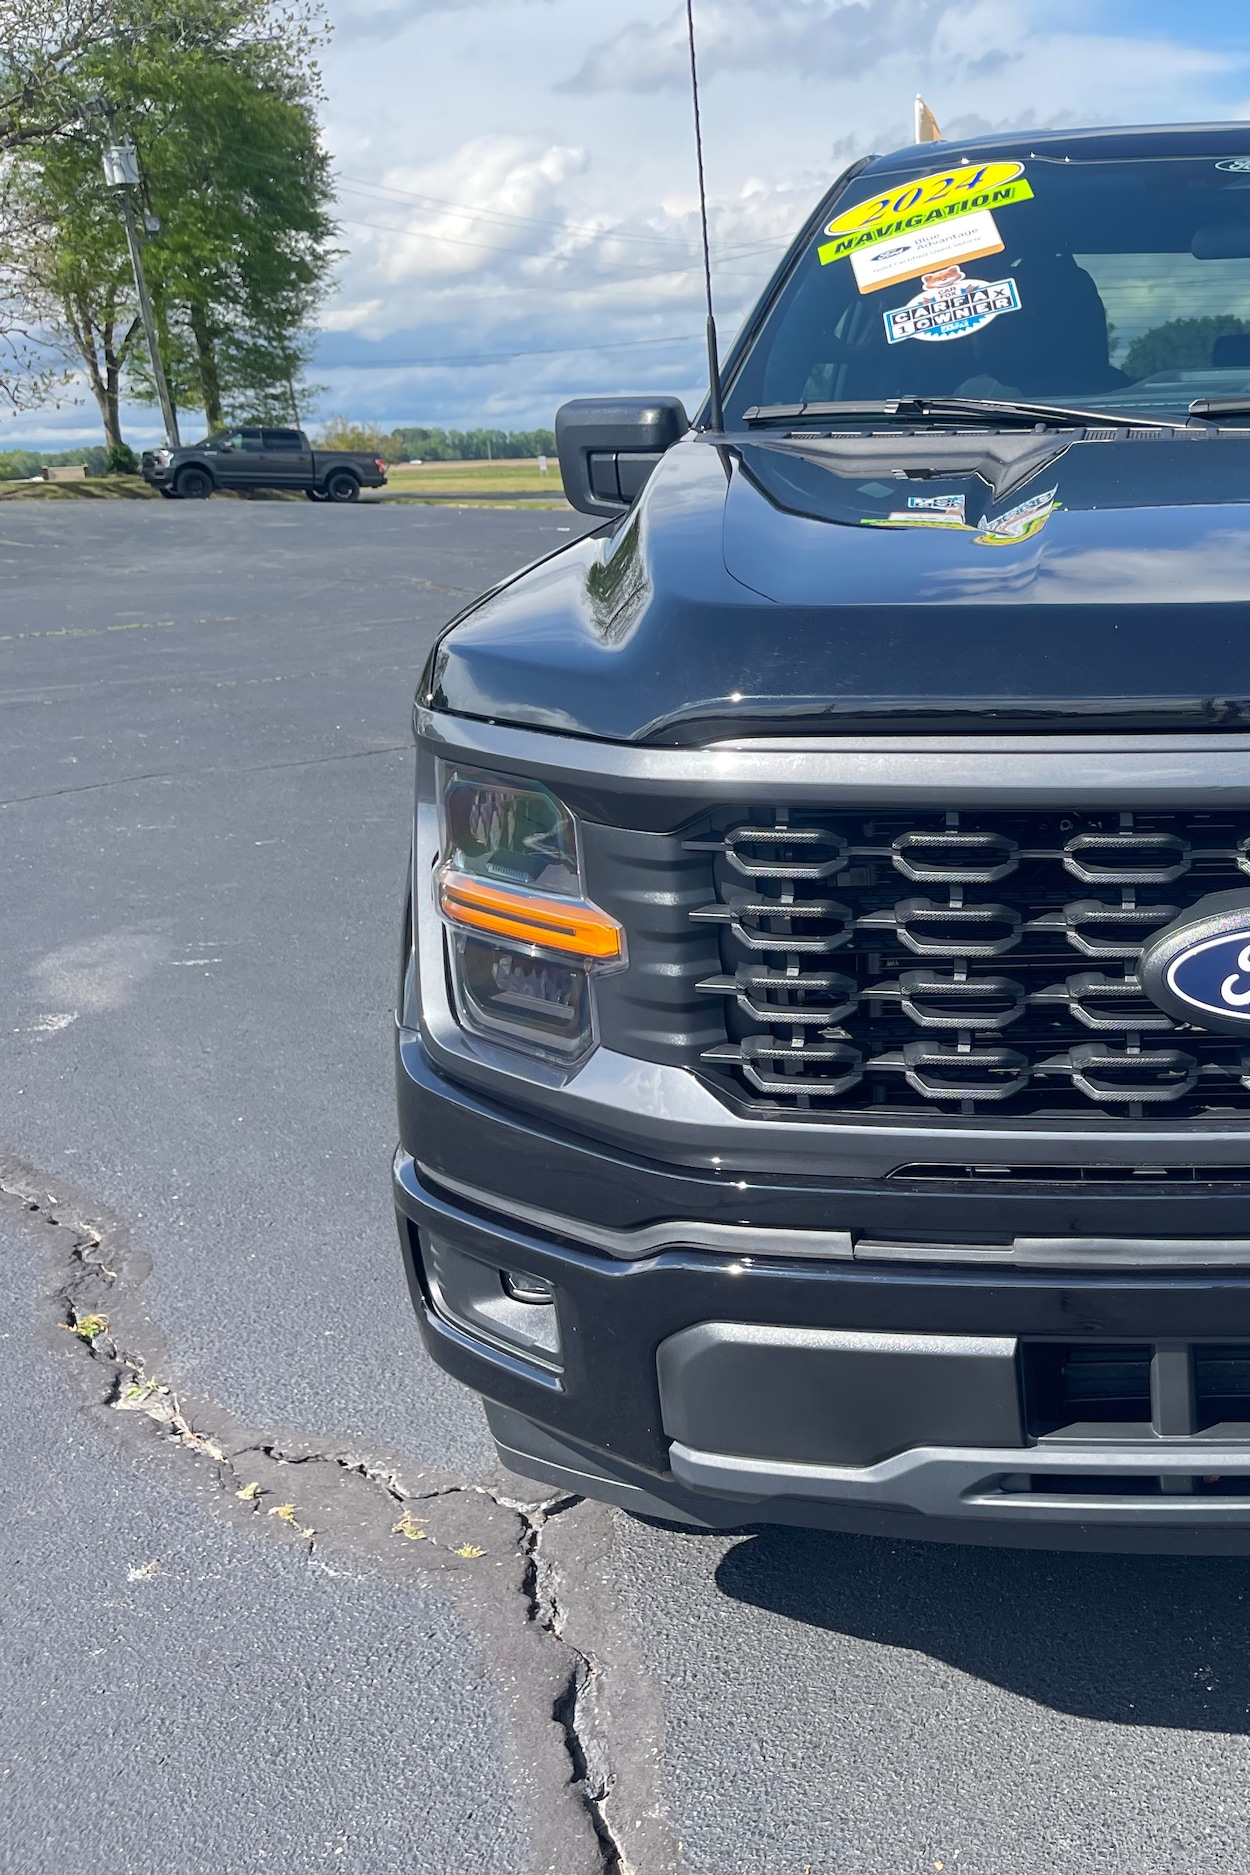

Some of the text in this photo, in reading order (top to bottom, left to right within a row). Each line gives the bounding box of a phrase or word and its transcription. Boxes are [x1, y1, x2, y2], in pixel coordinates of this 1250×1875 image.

[858, 166, 988, 226] 2024
[834, 187, 1015, 255] NAVIGATION
[914, 233, 940, 245] Blue
[917, 228, 978, 251] Advantage
[938, 286, 957, 295] CAR
[940, 291, 957, 299] FOX
[893, 288, 1005, 323] CARFAX
[898, 296, 1013, 335] 1 OWNER
